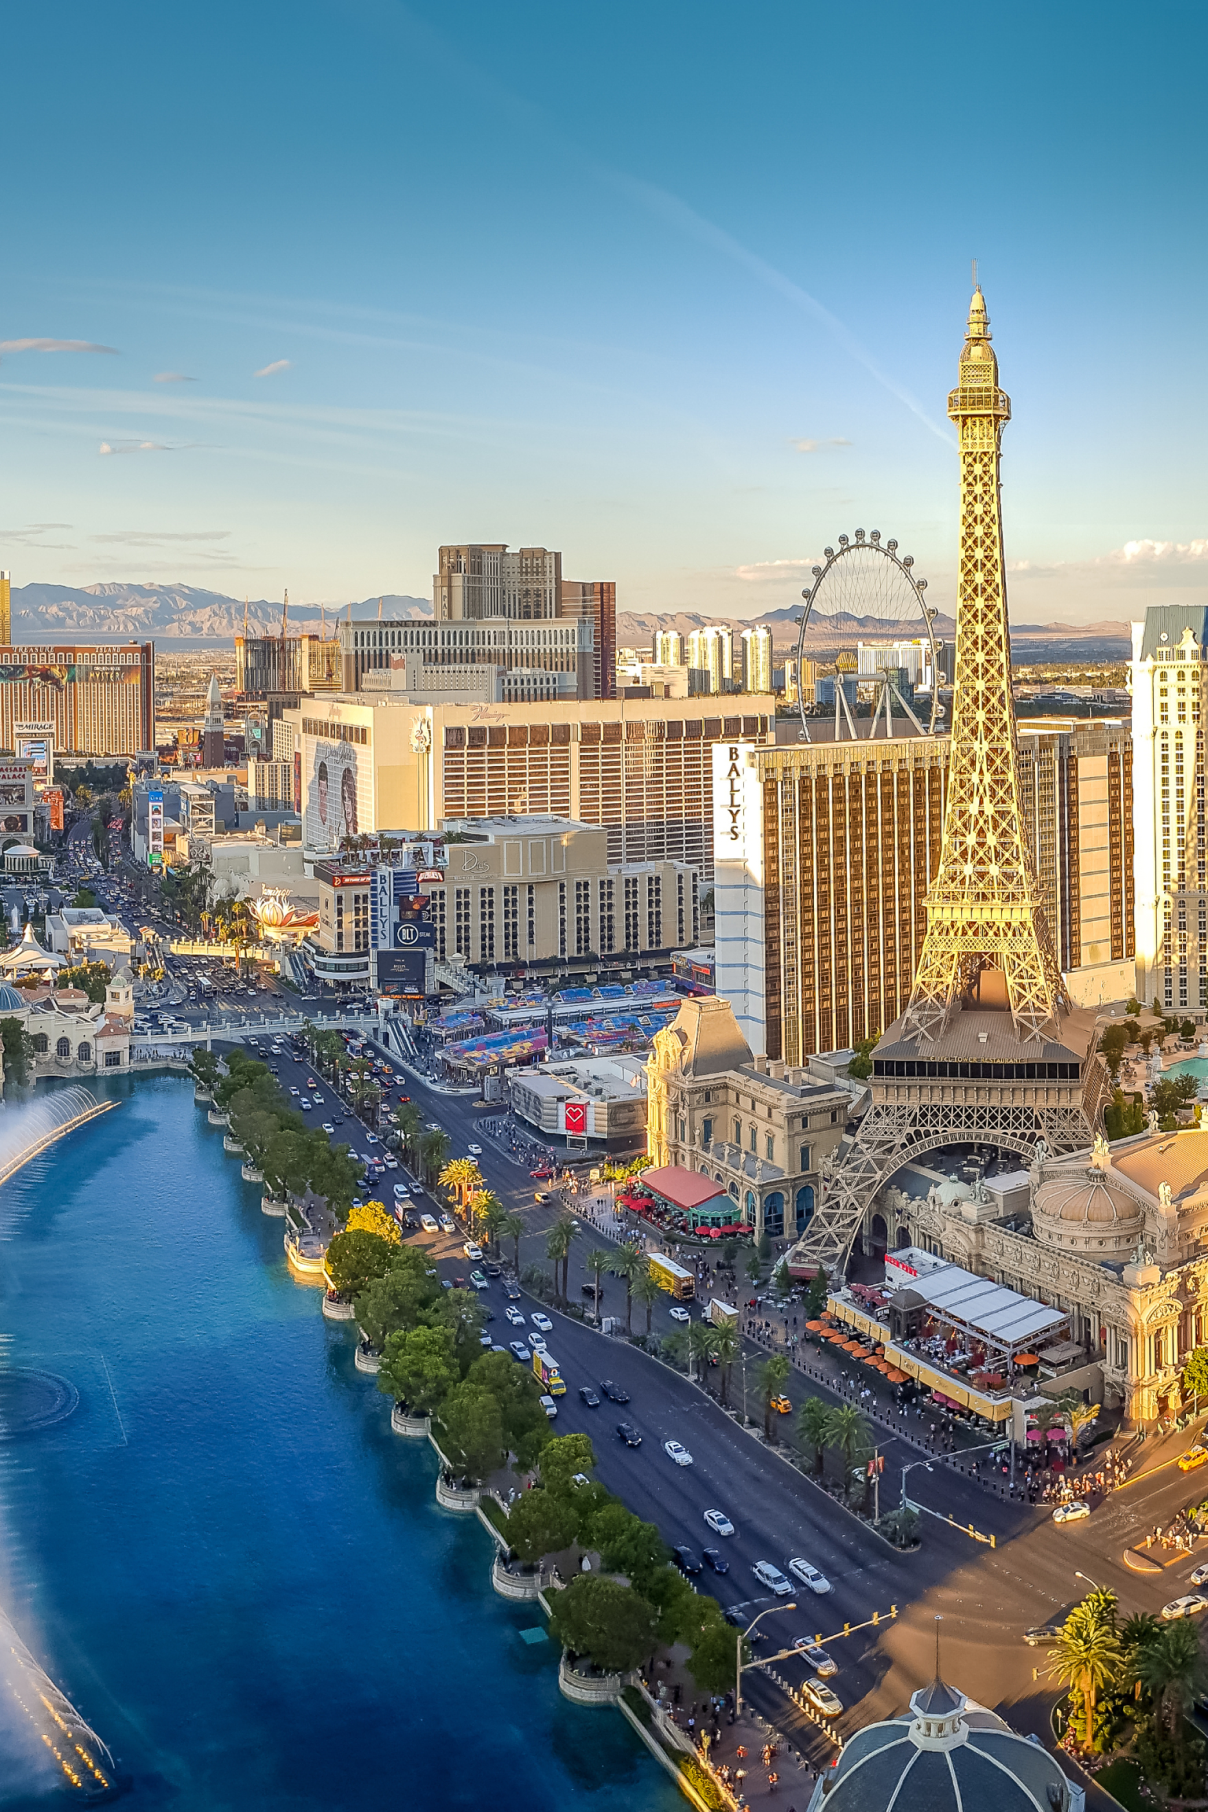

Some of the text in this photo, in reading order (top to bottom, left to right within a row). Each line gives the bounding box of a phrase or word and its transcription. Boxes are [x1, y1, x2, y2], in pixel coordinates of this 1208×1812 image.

[23, 723, 54, 731] MIRAGE
[401, 928, 414, 941] BLT
[980, 1056, 1022, 1064] RESTAURANT
